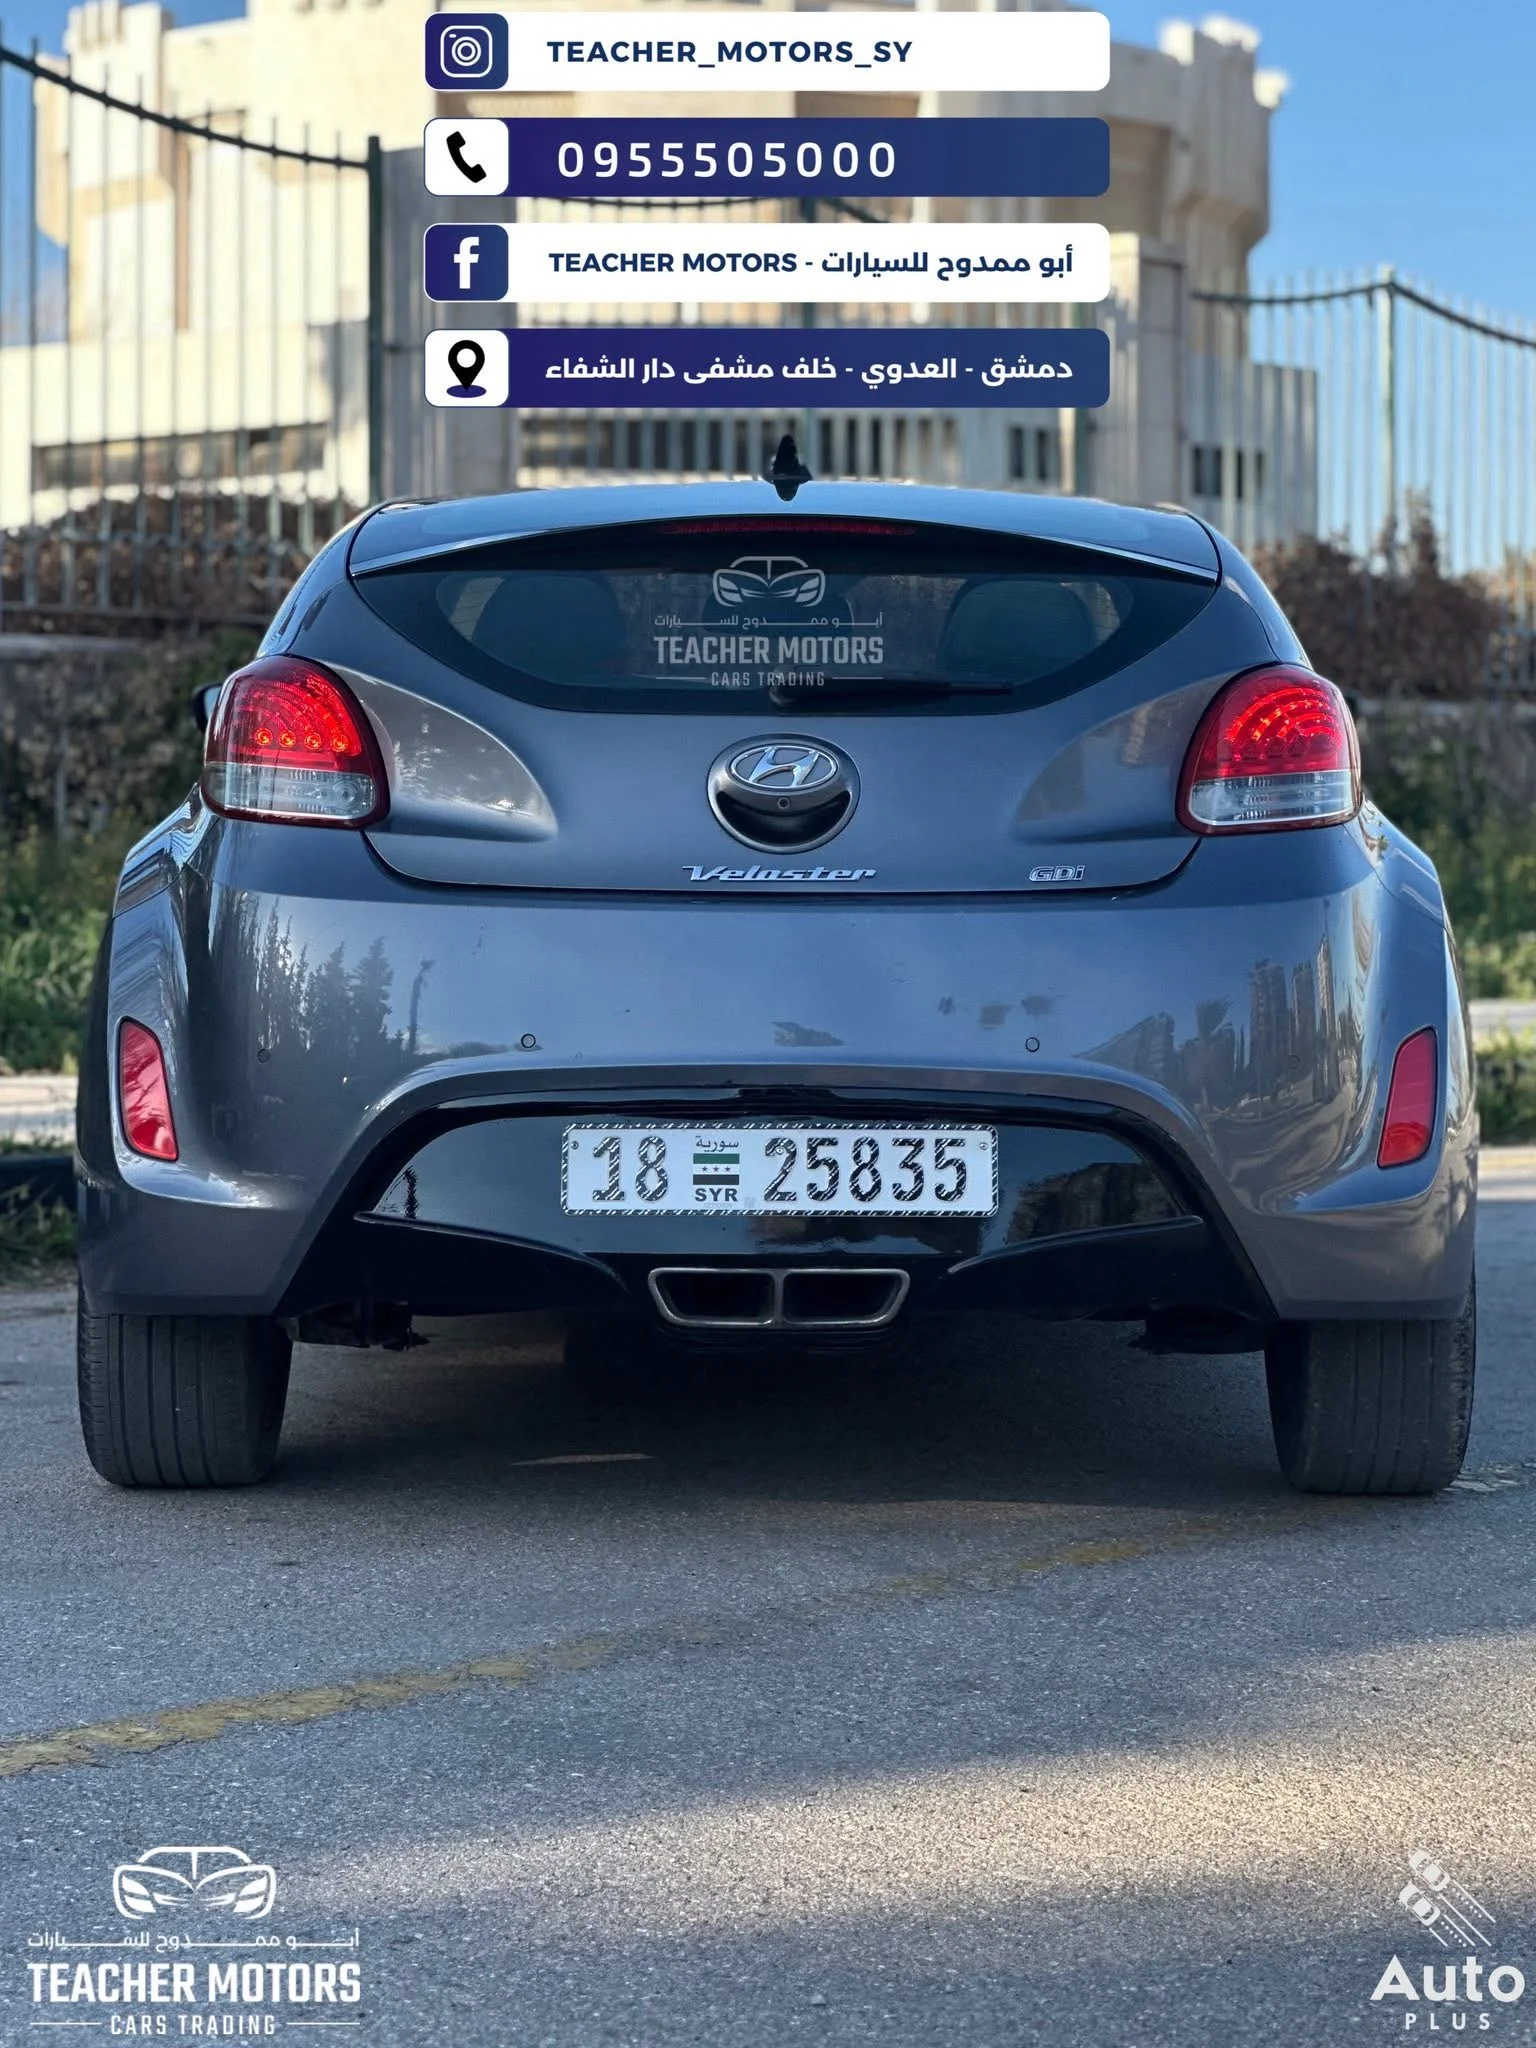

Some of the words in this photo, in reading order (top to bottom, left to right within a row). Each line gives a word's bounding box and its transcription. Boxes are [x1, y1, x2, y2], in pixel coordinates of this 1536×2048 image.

[682, 865, 877, 882] Veloster
[1028, 864, 1086, 882] GDi
[695, 1135, 740, 1153] سورية
[592, 1136, 669, 1202] 18
[764, 1136, 968, 1202] 25835
[694, 1187, 738, 1202] SYR
